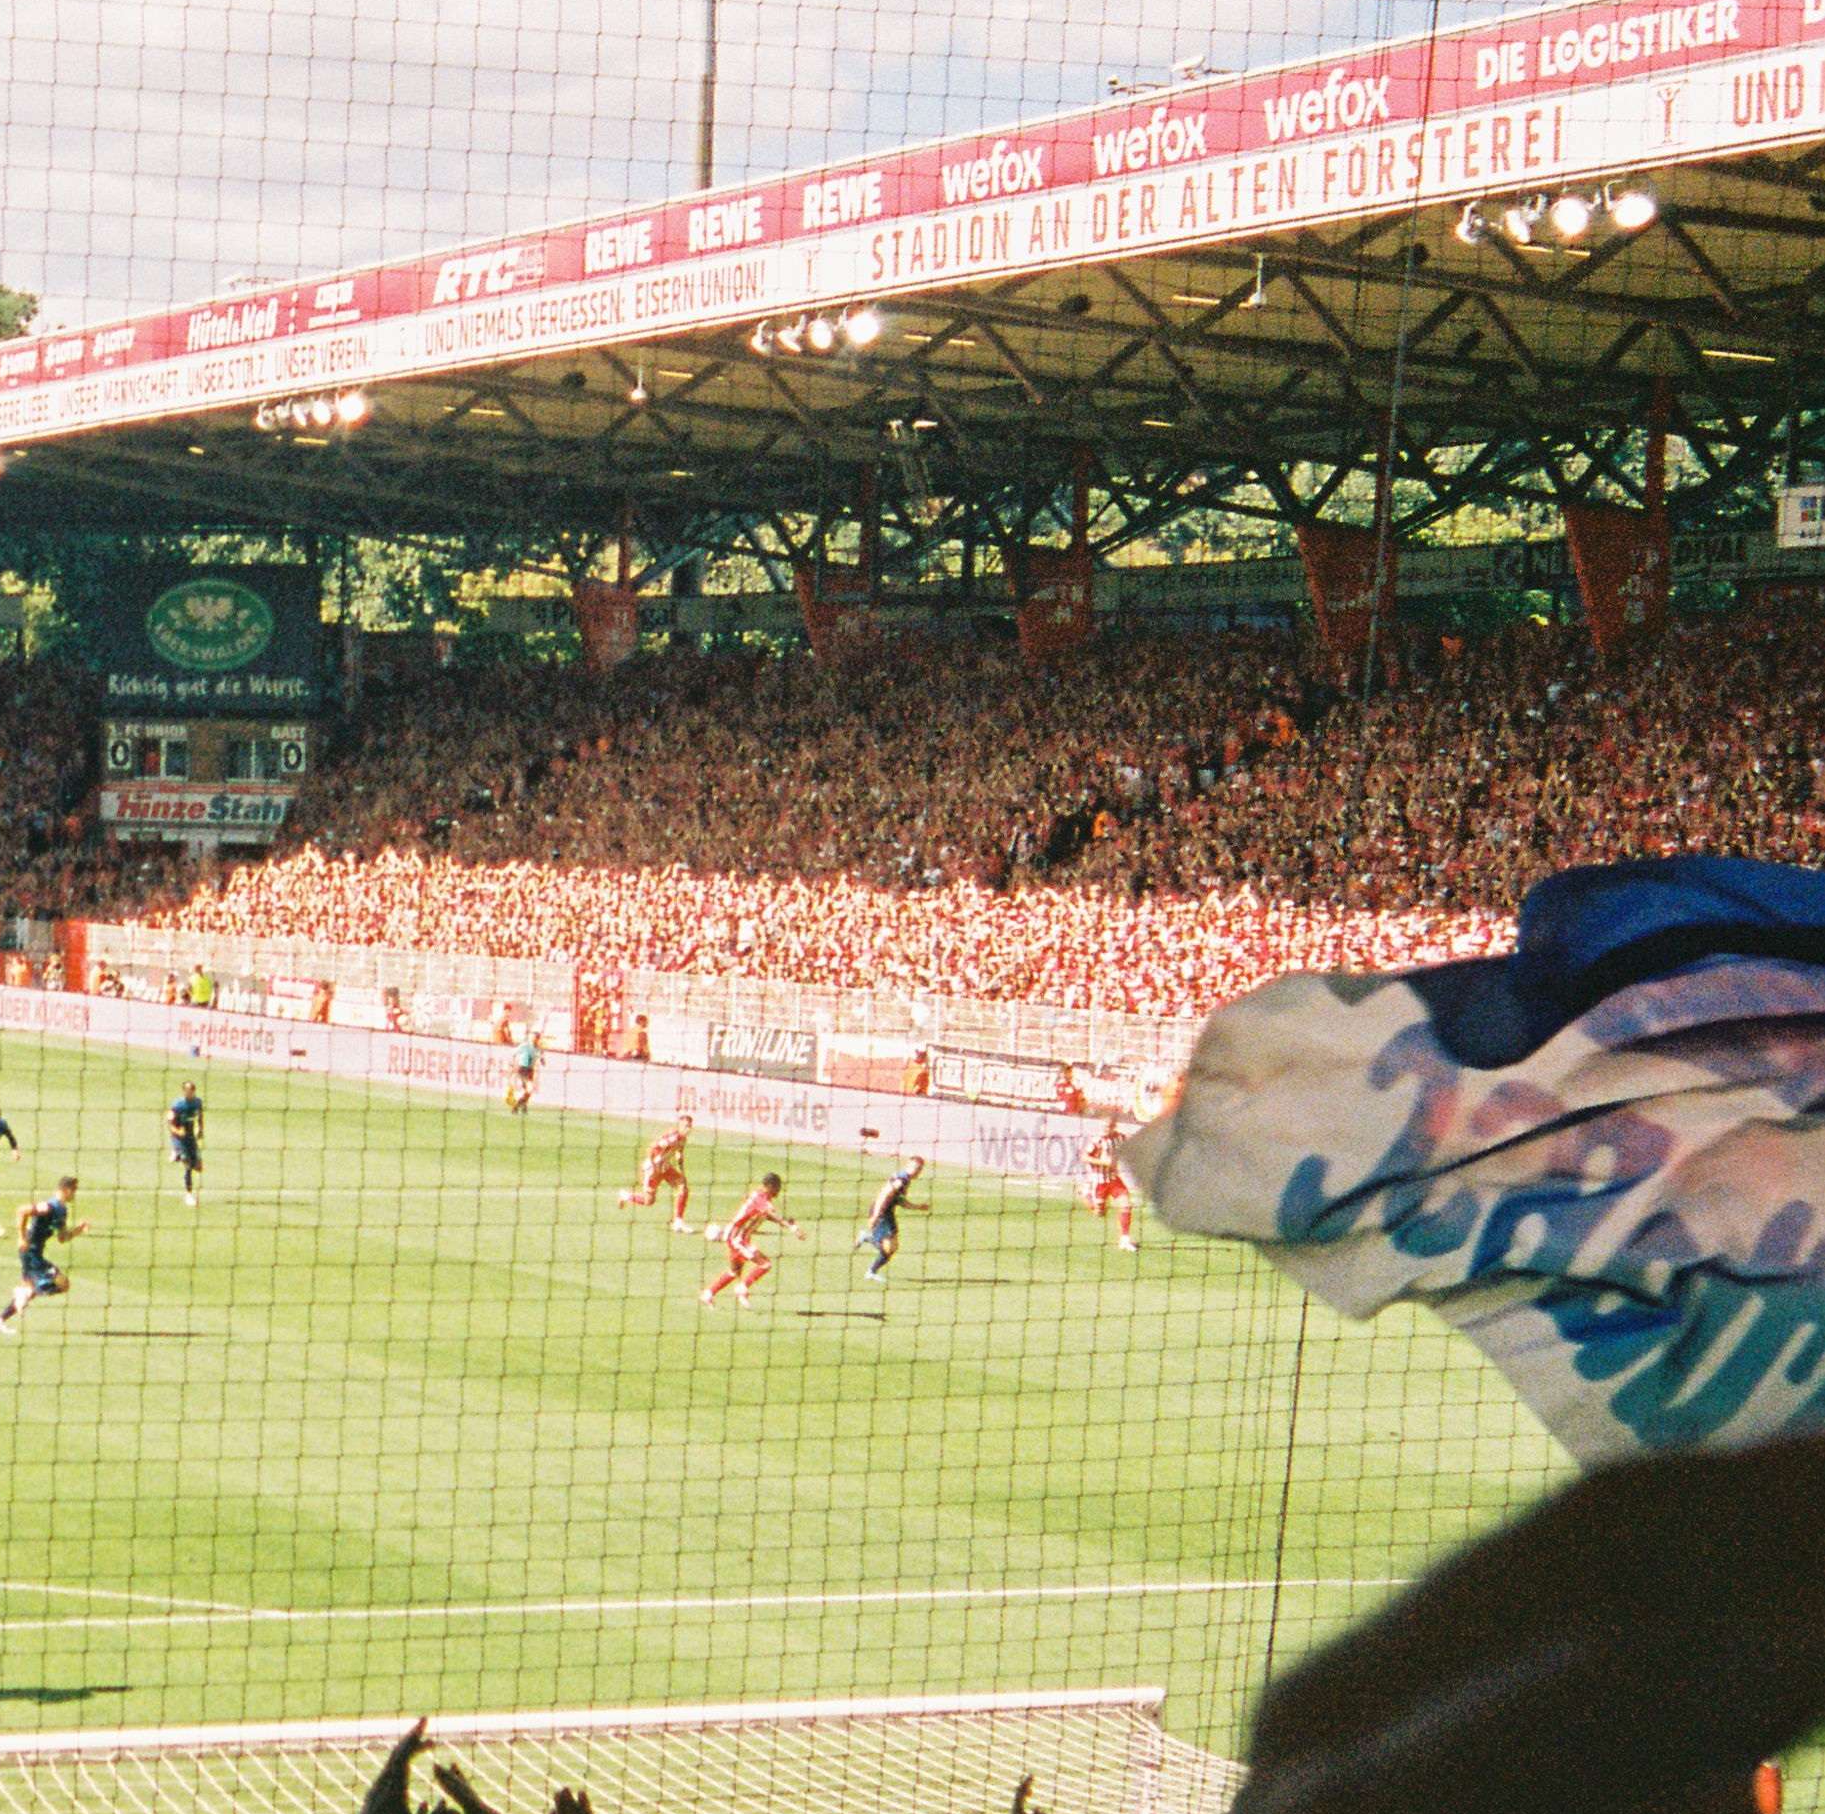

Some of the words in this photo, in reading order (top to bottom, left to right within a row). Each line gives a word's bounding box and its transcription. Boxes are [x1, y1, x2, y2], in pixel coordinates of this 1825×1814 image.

[1476, 41, 1525, 90] DIE
[1263, 67, 1390, 141] wefox
[1732, 64, 1804, 128] UND
[1093, 107, 1207, 176] wefox
[872, 210, 1010, 282] STADION
[1029, 199, 1071, 255] AN
[1092, 183, 1157, 244] DER
[1178, 154, 1297, 230] ALTEN
[1322, 106, 1563, 204] FÖRSTEREI
[942, 139, 1043, 206] wefox
[688, 196, 763, 253] REWE
[802, 171, 884, 230] REWE
[584, 221, 652, 275] REWE
[425, 319, 455, 356] UND
[459, 302, 525, 349] NIEMALS
[635, 269, 696, 319] EISERN
[700, 261, 767, 306] UNION!
[111, 740, 129, 767] 0
[283, 742, 302, 771] 0
[179, 1017, 275, 1054] m-ruder.de
[388, 1044, 452, 1082] RUDER
[710, 1024, 816, 1065] FRONTLINE
[678, 1084, 830, 1132] m-ruder.de
